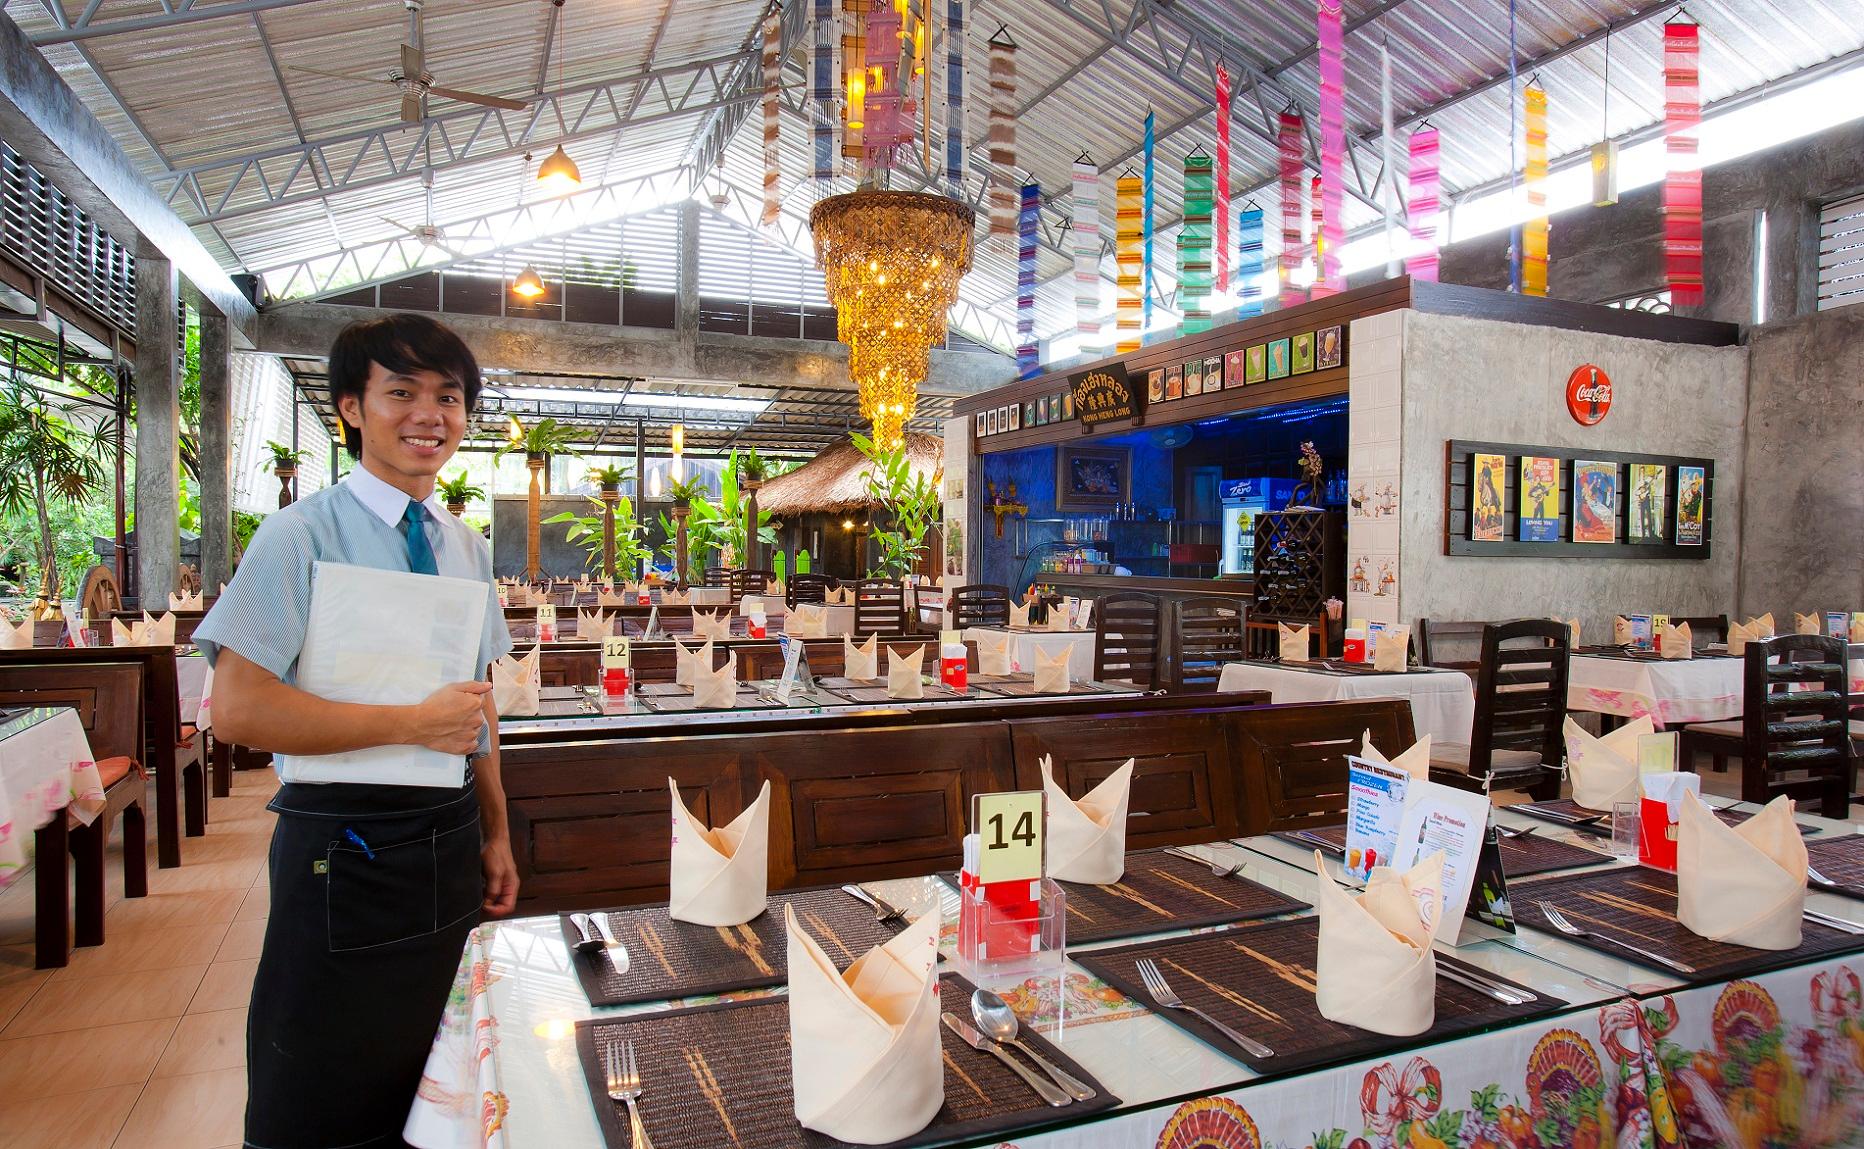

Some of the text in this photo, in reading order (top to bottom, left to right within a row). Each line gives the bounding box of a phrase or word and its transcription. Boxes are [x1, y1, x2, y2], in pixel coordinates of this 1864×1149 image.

[1576, 383, 1612, 403] Coca-Cola
[1114, 406, 1131, 417] LONG
[1229, 485, 1252, 497] Zero
[1275, 489, 1306, 501] SANO
[540, 608, 553, 618] 11
[606, 643, 627, 657] 12
[1351, 784, 1379, 797] Smoothies
[1444, 815, 1466, 829] Promotion
[988, 811, 1036, 850] 14
